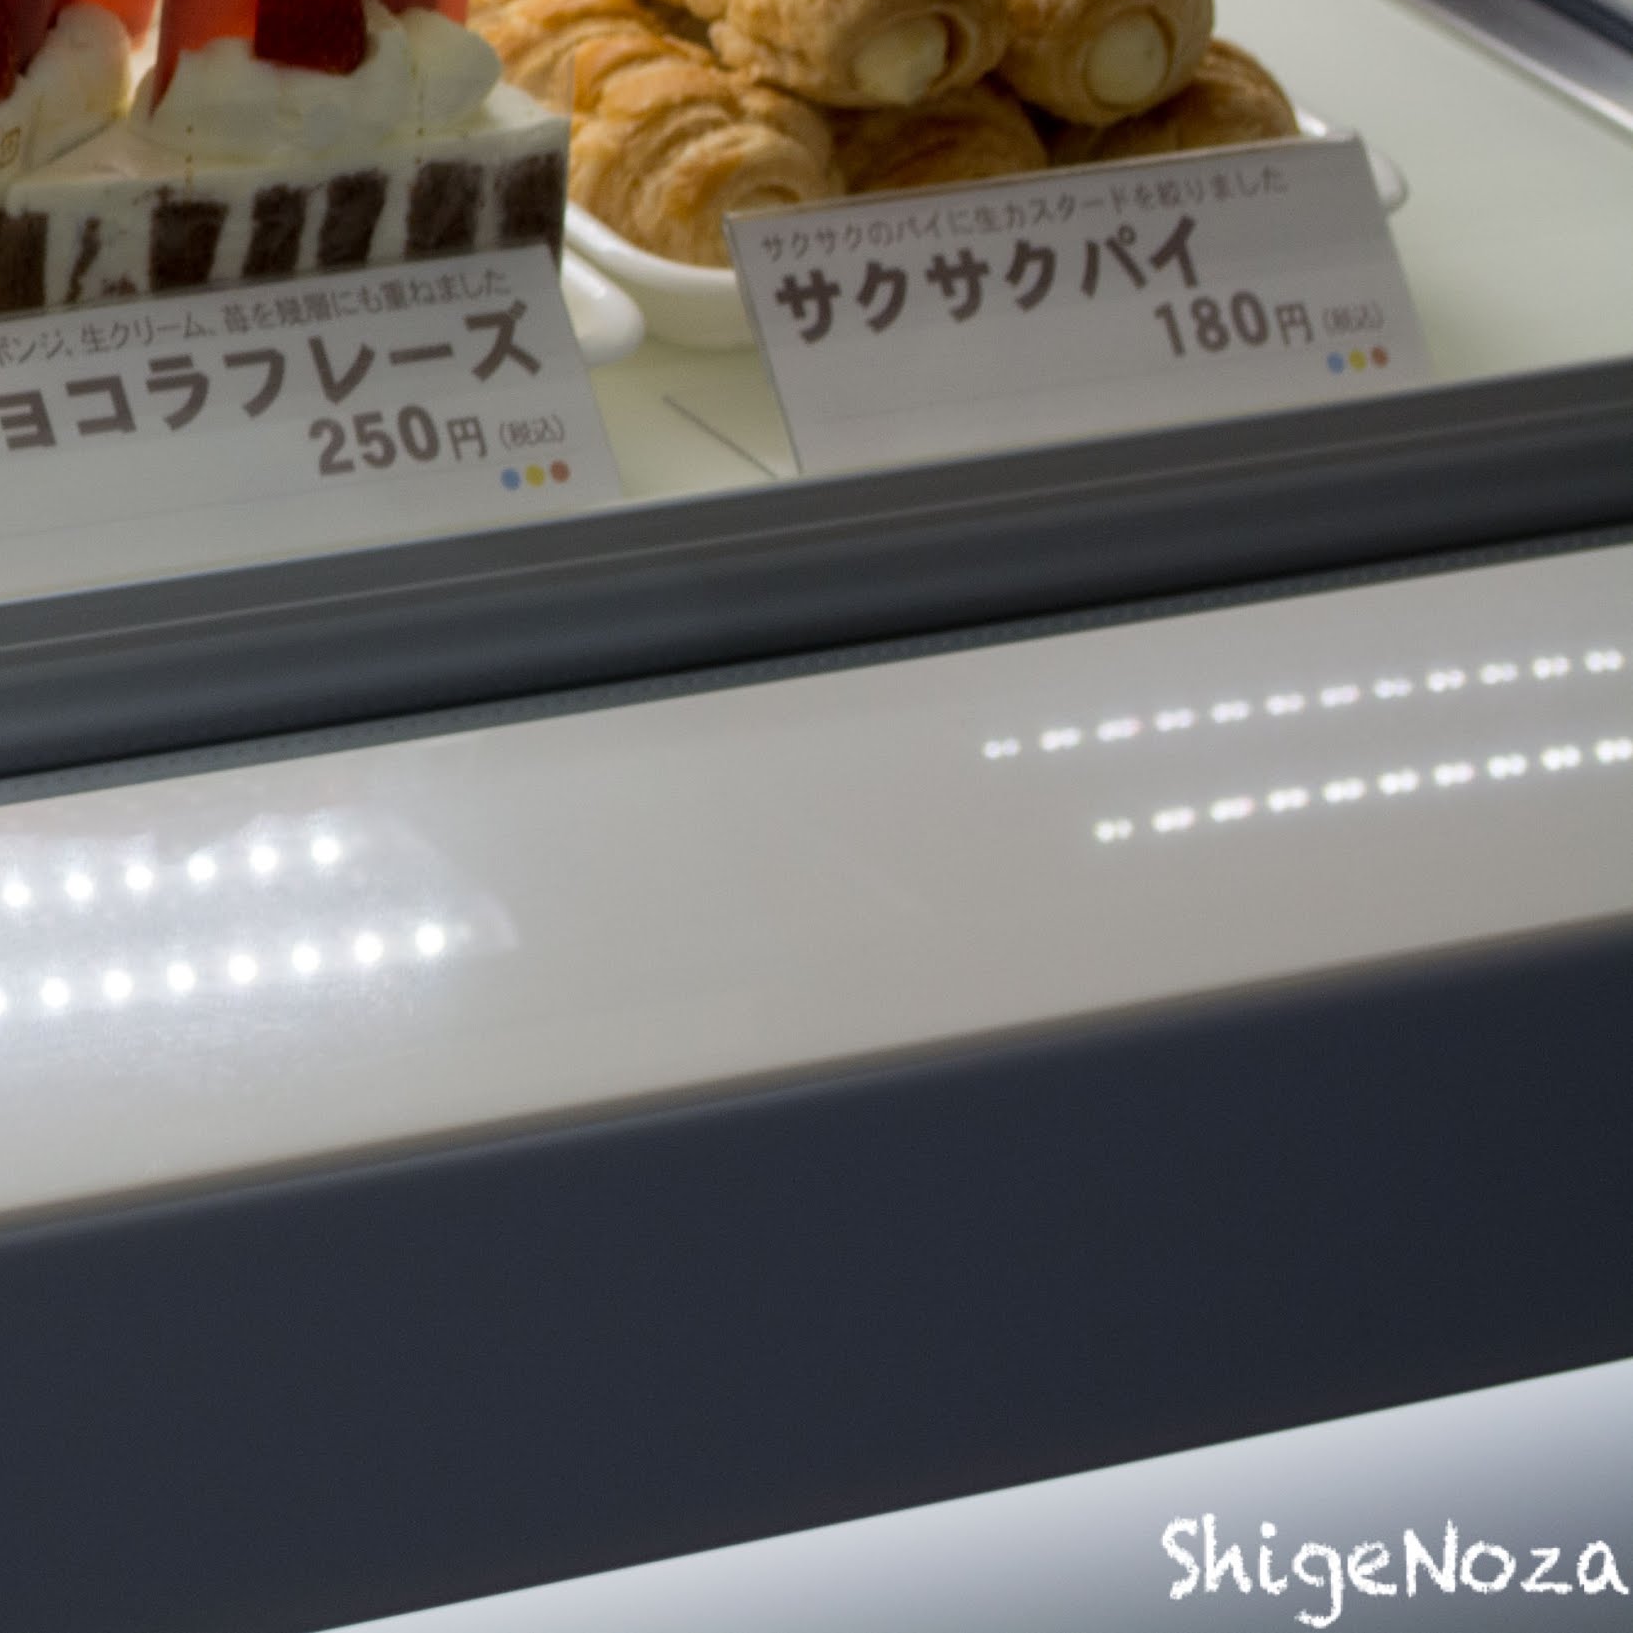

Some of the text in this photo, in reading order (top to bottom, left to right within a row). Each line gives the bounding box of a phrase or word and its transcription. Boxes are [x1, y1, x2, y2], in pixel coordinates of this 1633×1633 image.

[776, 216, 1198, 344] サクサクパイ
[1153, 291, 1312, 356] 180円
[308, 406, 487, 476] 250円
